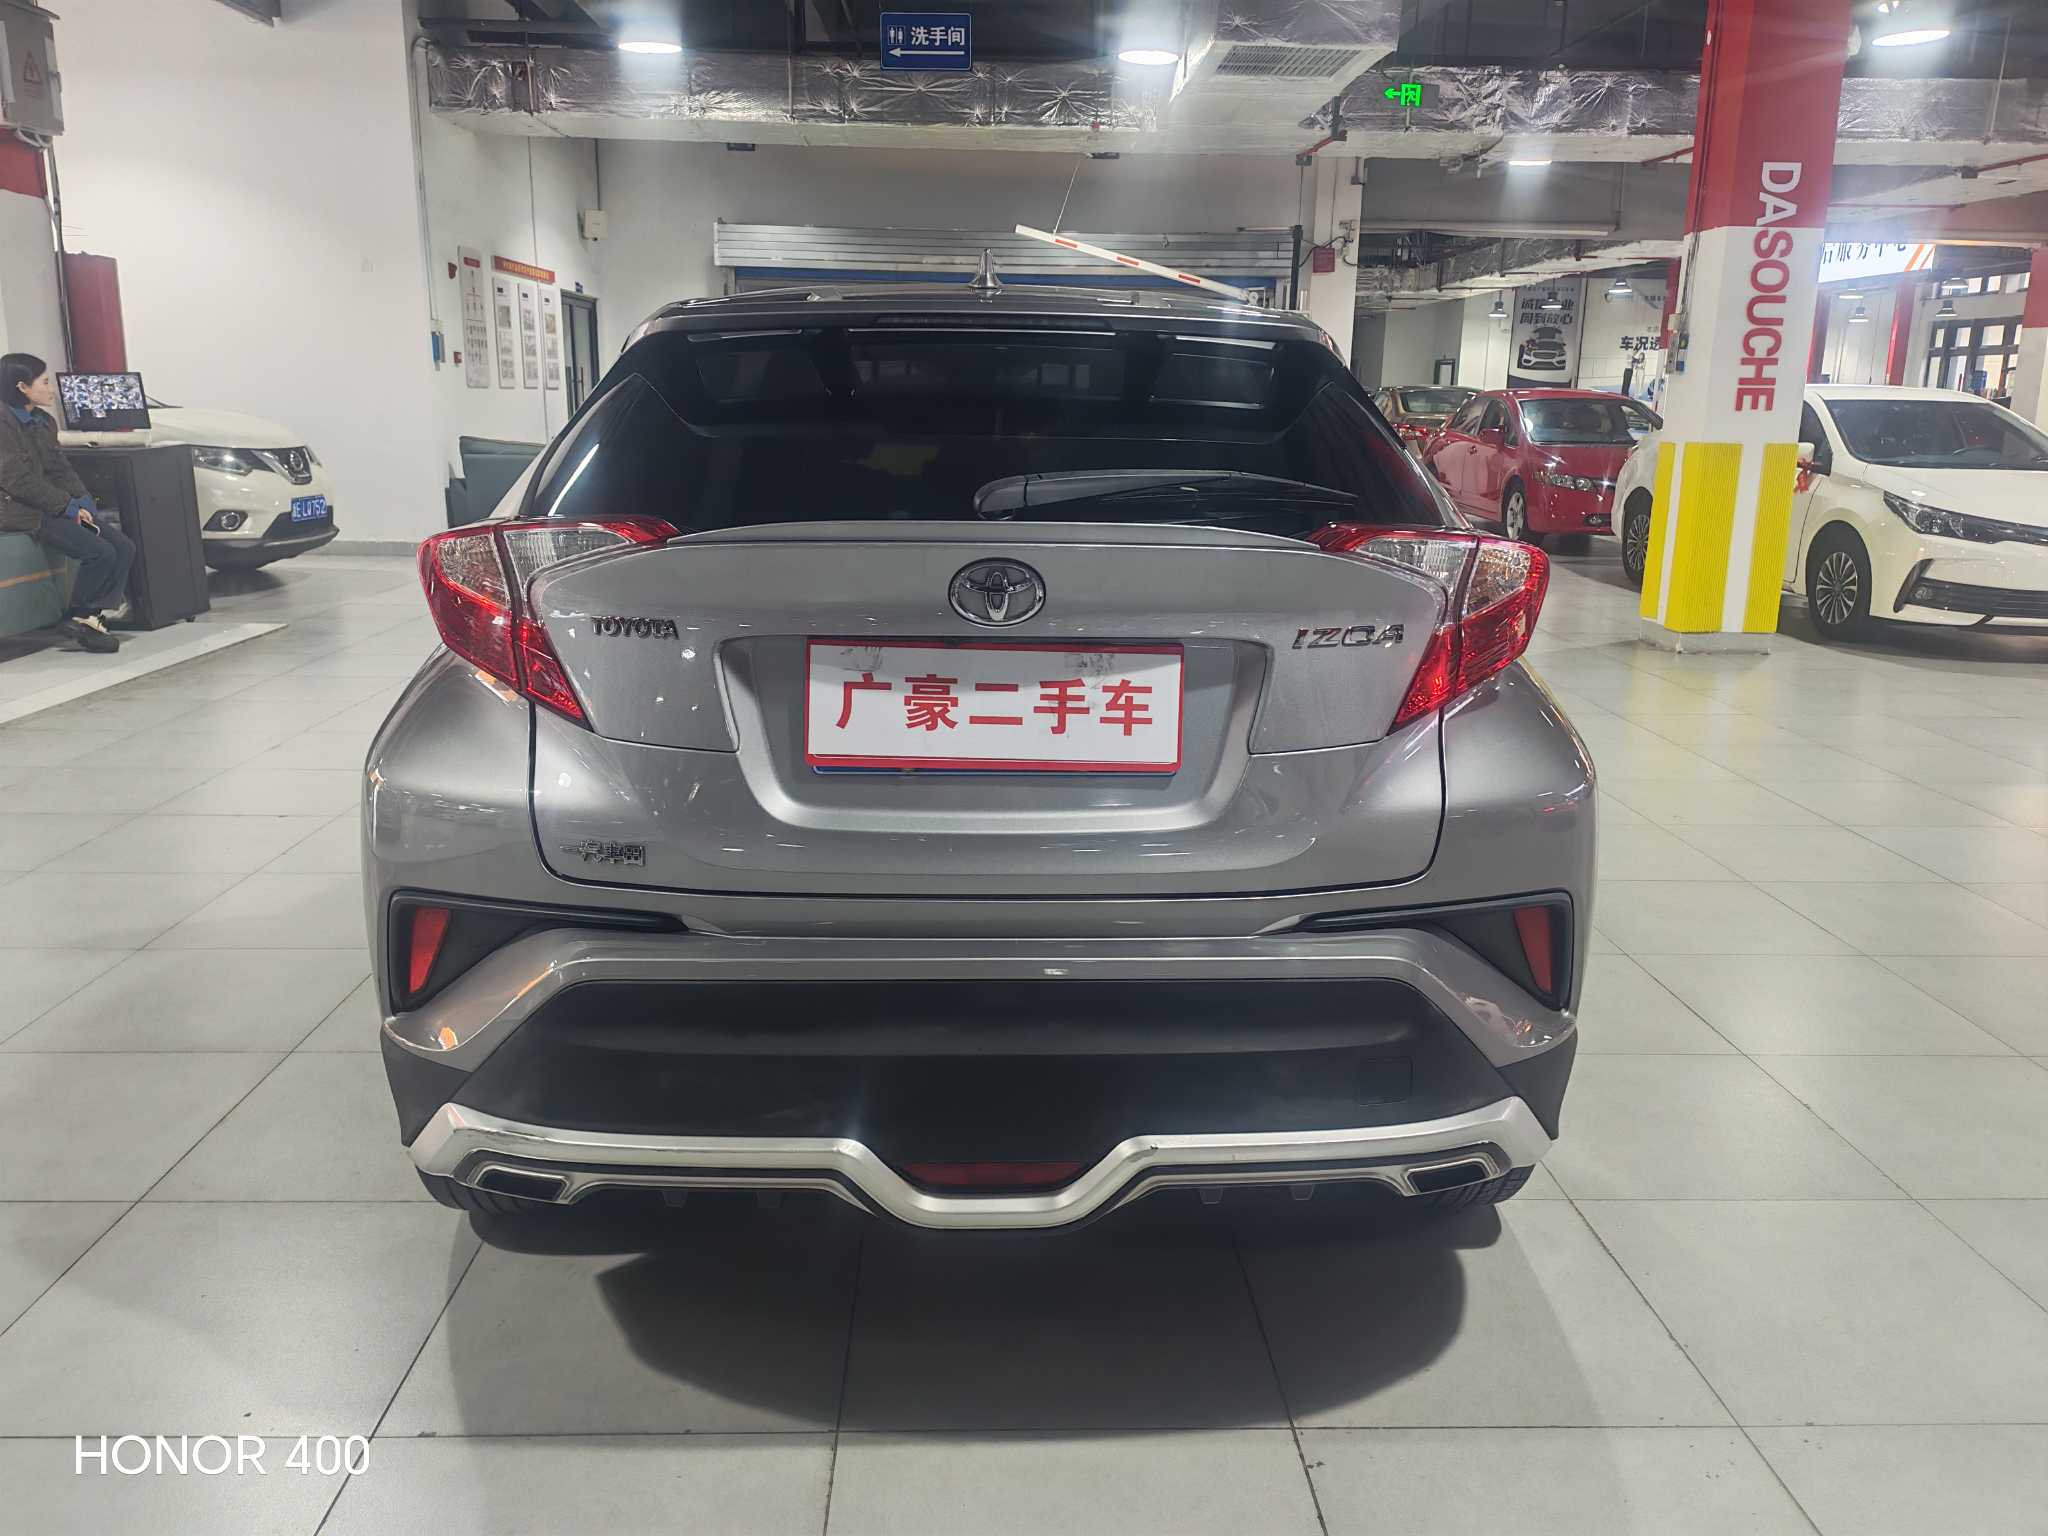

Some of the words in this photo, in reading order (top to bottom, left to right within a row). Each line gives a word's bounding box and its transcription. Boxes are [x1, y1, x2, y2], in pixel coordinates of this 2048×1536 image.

[911, 26, 965, 46] 洗手间
[1735, 161, 1802, 412] DASOUCHE
[590, 615, 680, 640] TOYOTA
[1291, 623, 1405, 650] IZOA
[835, 671, 1153, 737] 广豪二手车
